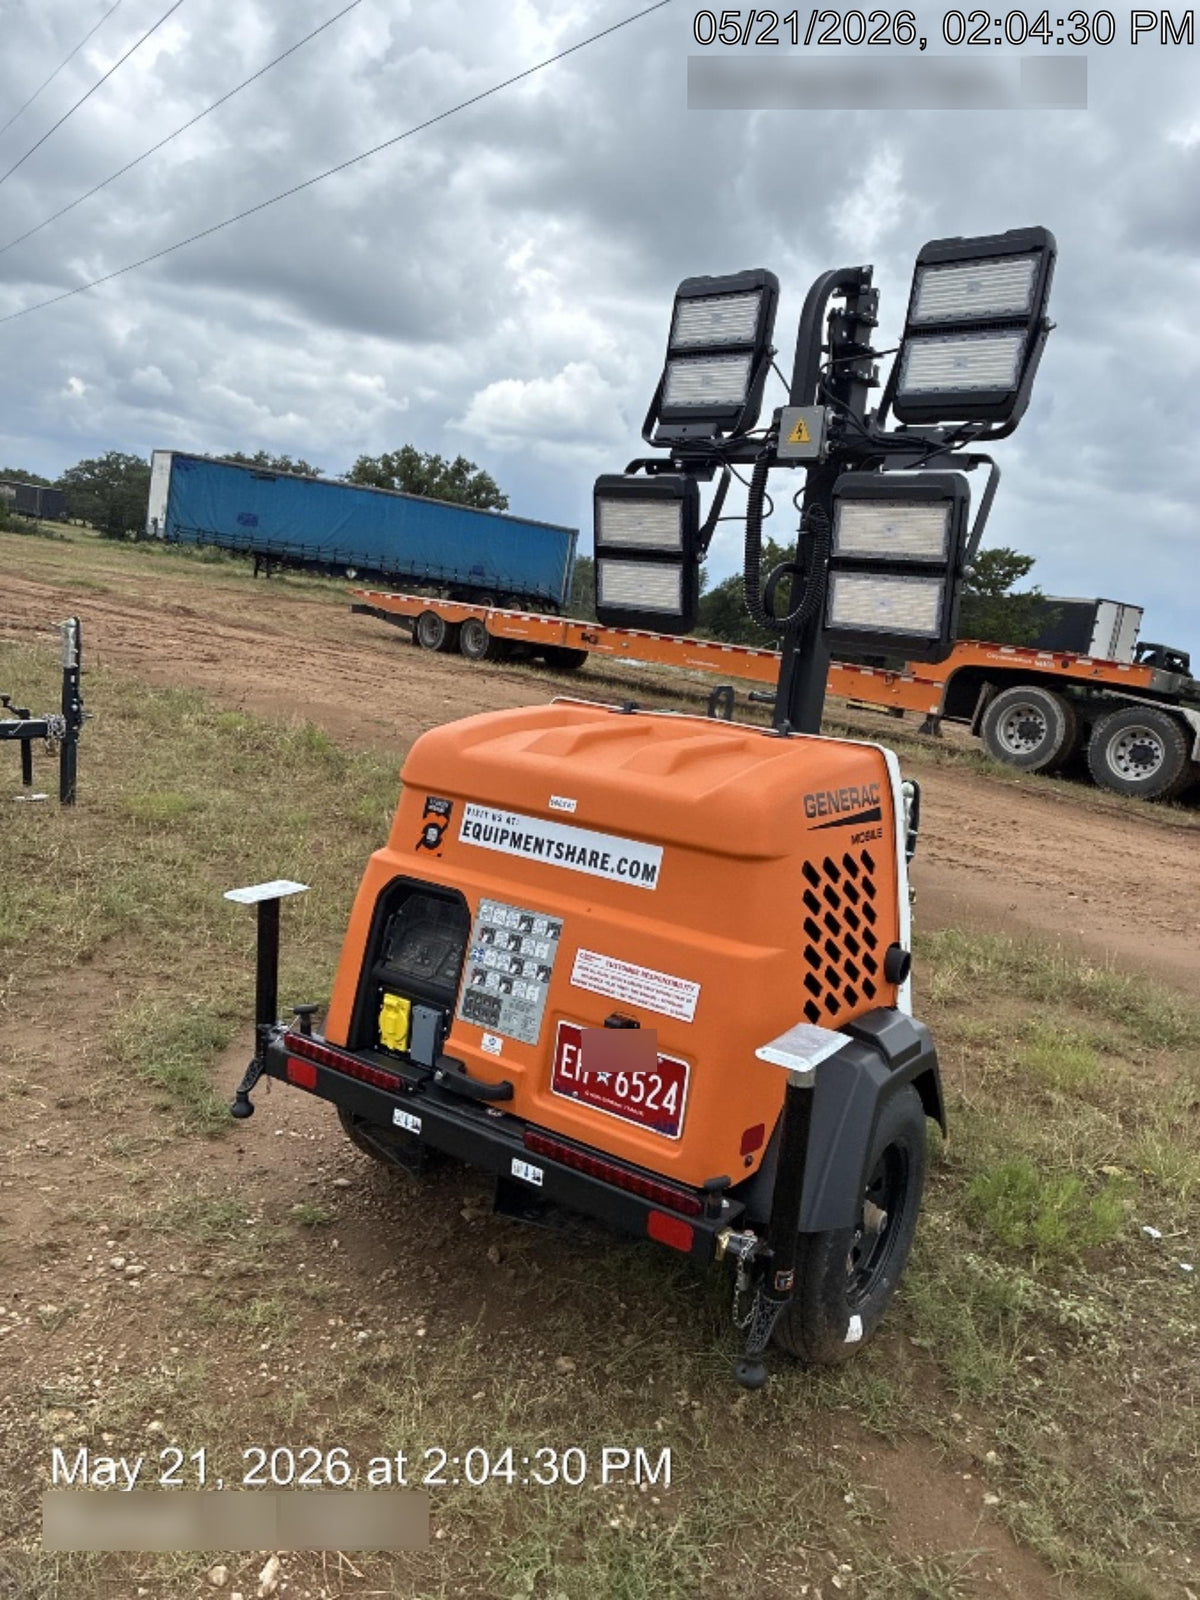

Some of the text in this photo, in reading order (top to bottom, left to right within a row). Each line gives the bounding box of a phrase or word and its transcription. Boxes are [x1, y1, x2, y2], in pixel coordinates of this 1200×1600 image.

[803, 784, 880, 819] GENERAC
[461, 820, 657, 883] EQUIPMENTSHARE.COM
[850, 828, 882, 845] MOBILE
[614, 1071, 678, 1116] 6524
